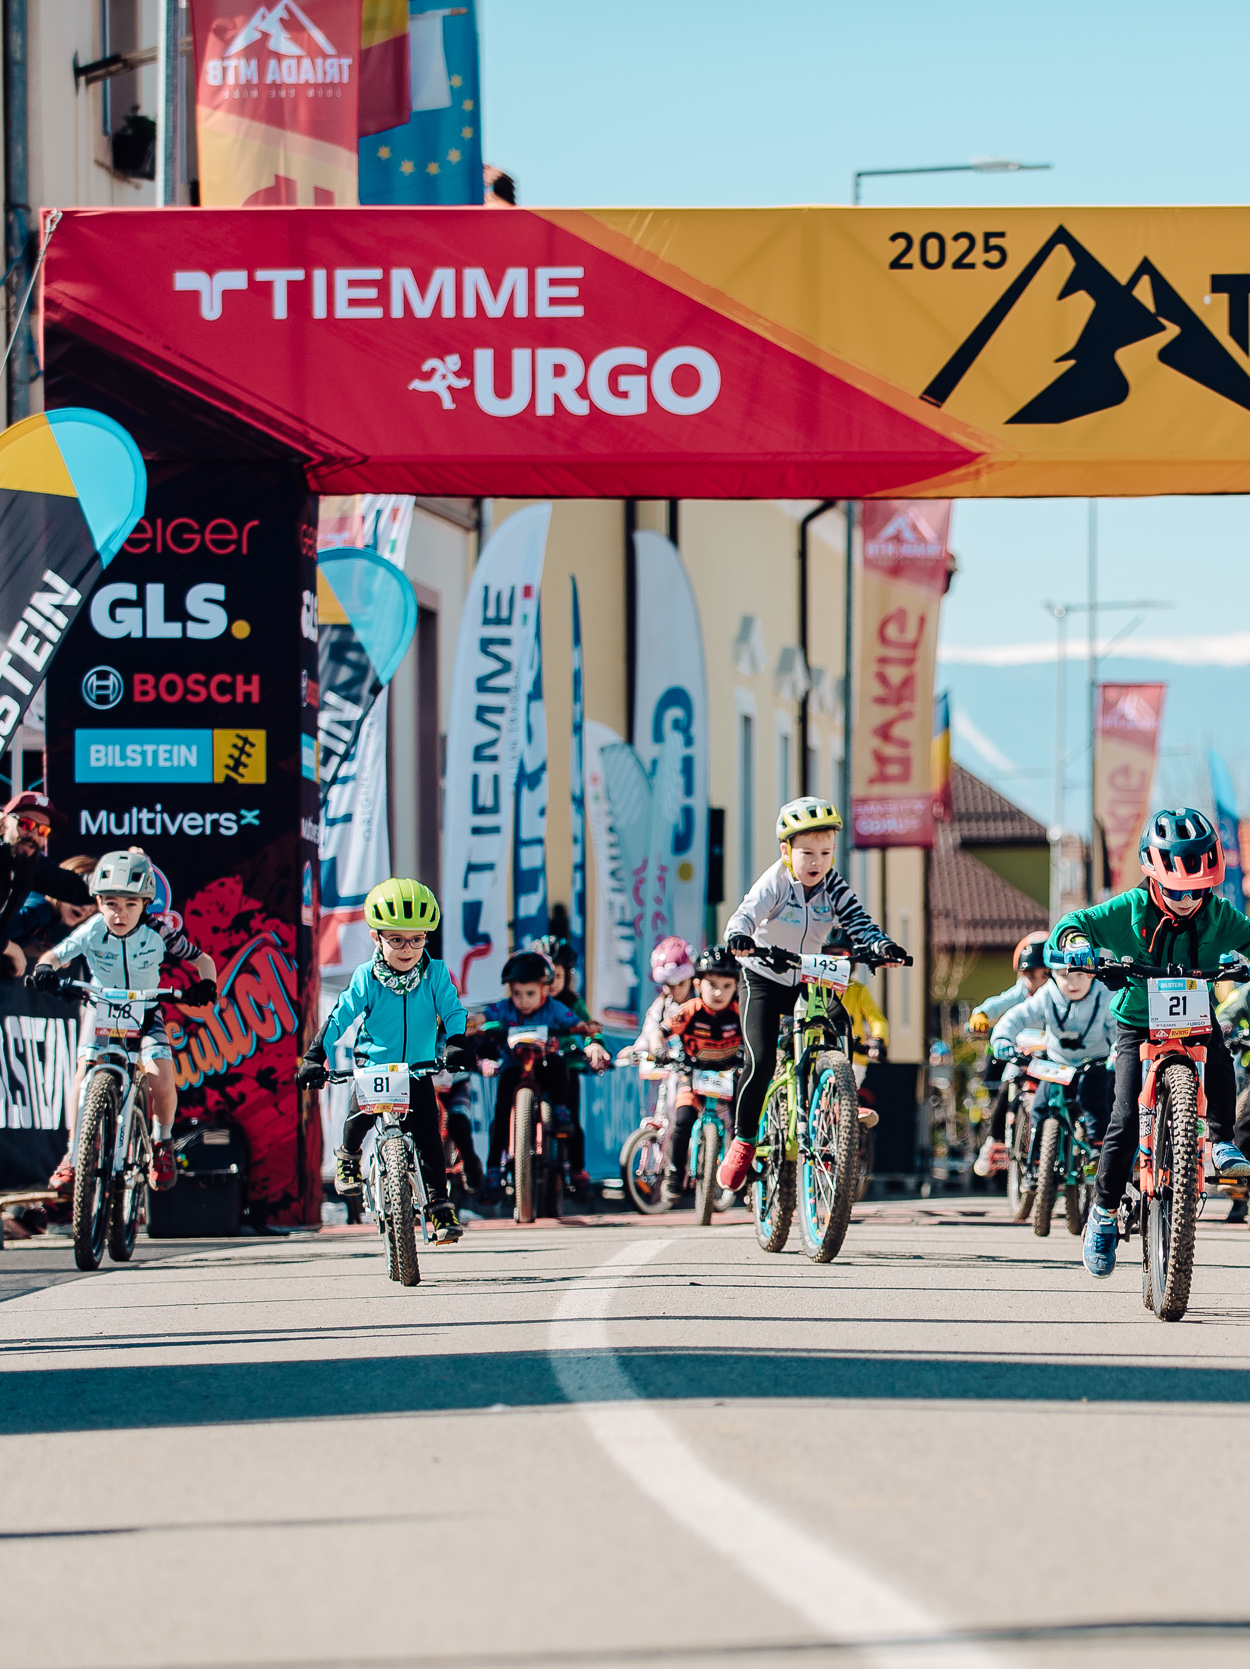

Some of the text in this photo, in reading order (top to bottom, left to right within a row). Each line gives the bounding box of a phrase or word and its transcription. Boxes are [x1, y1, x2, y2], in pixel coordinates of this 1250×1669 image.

[889, 231, 1008, 270] 2025
[255, 267, 585, 319] TIEMME
[474, 345, 721, 417] URGO
[132, 672, 260, 704] BOSCH
[89, 744, 198, 768] BILSTEIN
[814, 957, 837, 972] 145
[1169, 995, 1187, 1016] 21
[373, 1077, 390, 1092] 81
